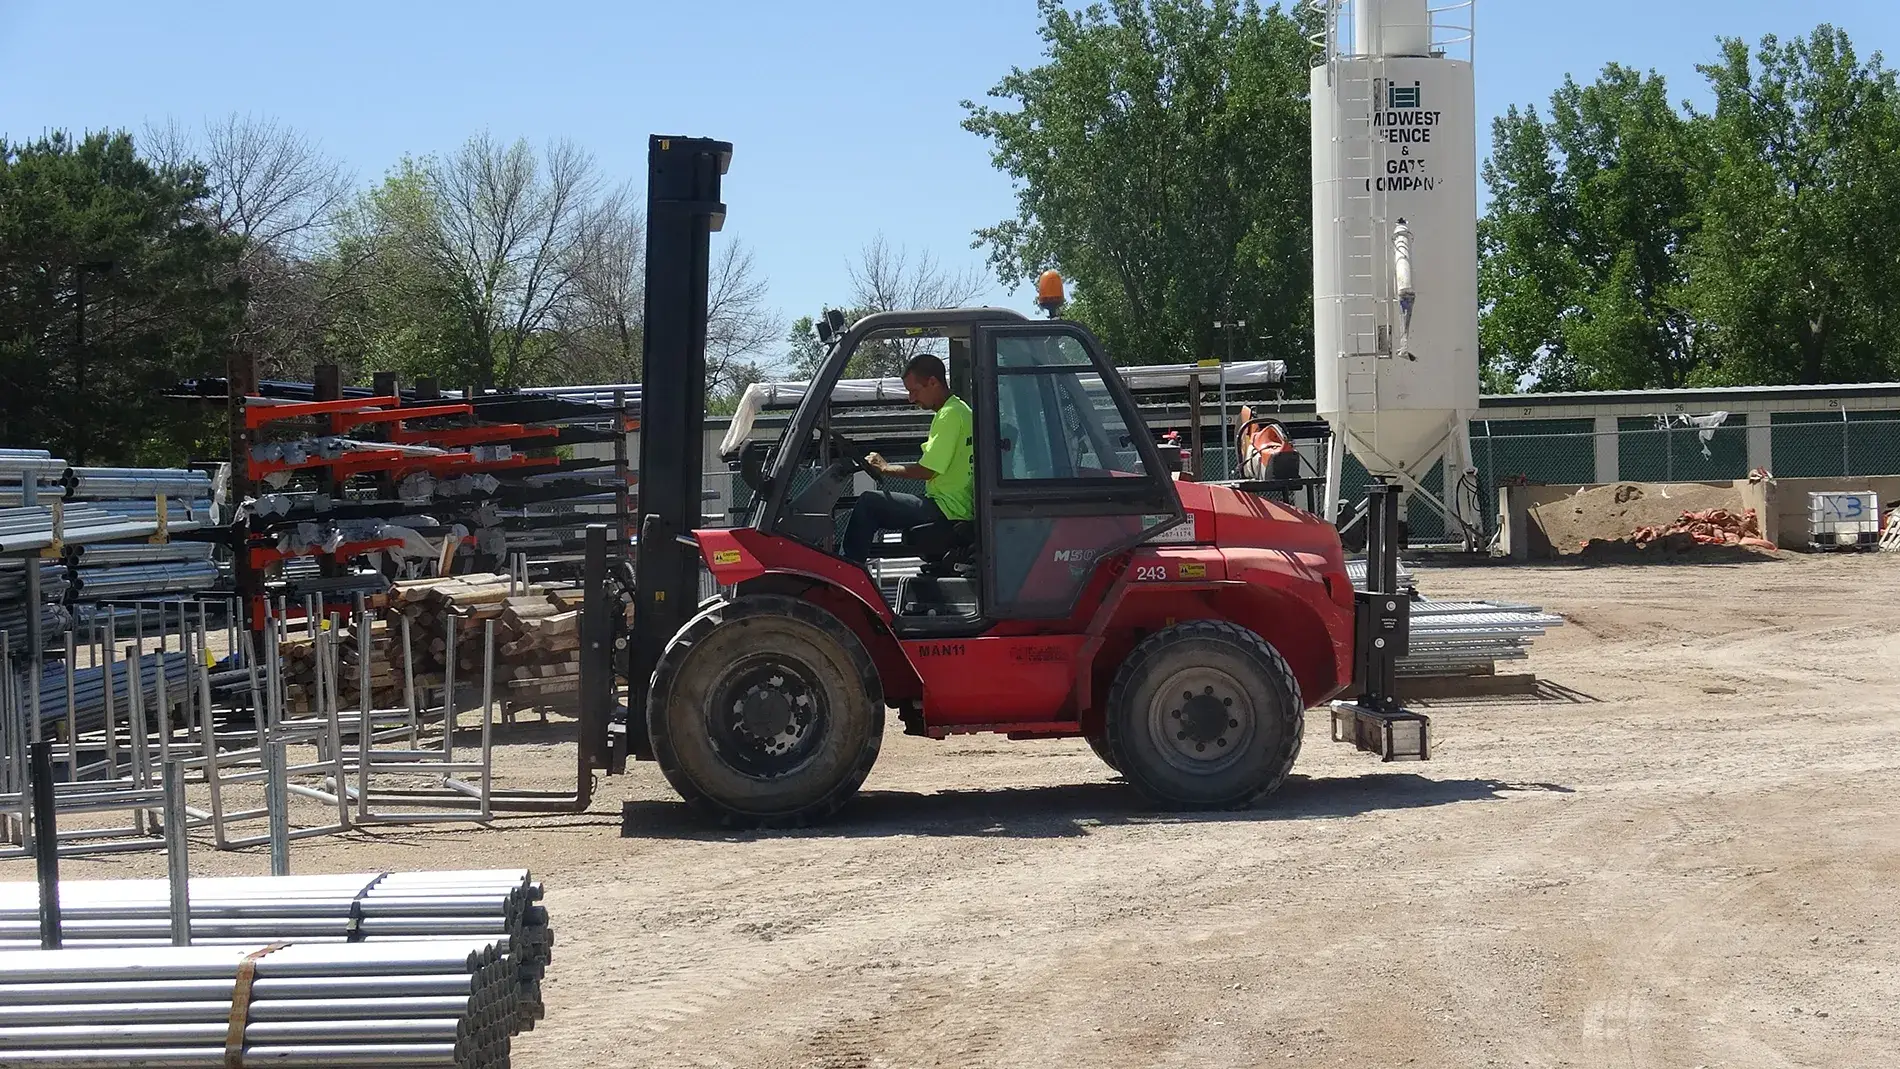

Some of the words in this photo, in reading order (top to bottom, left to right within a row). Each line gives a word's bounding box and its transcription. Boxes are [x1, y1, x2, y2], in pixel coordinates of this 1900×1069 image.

[1366, 111, 1441, 127] MIDWEST
[1401, 145, 1409, 156] &
[1365, 176, 1444, 192] COMPAN
[1675, 403, 1685, 412] 26
[1829, 399, 1838, 408] 25
[1523, 407, 1532, 416] 27
[1136, 566, 1167, 580] 243
[919, 644, 965, 657] MAN11
